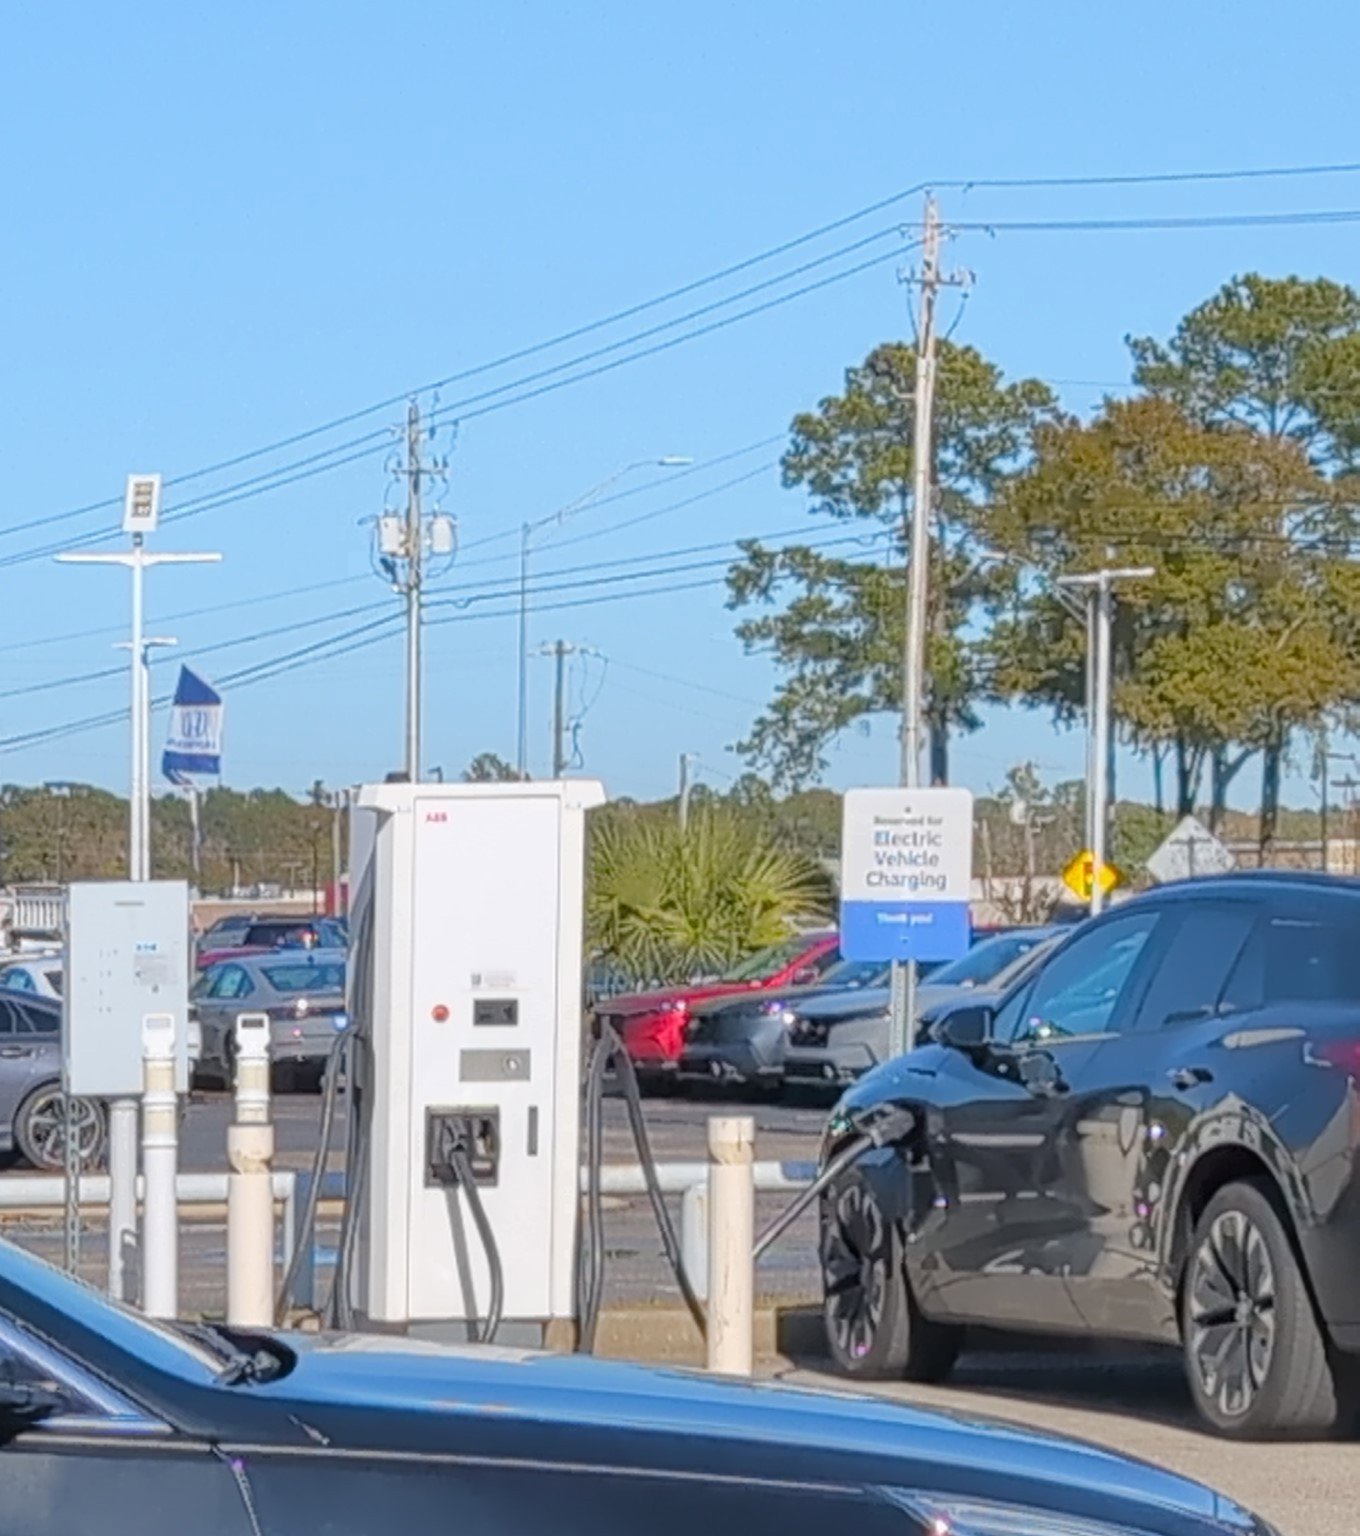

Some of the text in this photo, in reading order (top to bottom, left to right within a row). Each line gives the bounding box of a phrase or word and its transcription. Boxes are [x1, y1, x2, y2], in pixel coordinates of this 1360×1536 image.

[873, 829, 943, 847] Electric
[874, 850, 940, 867] Vehicle
[865, 870, 948, 891] Charging
